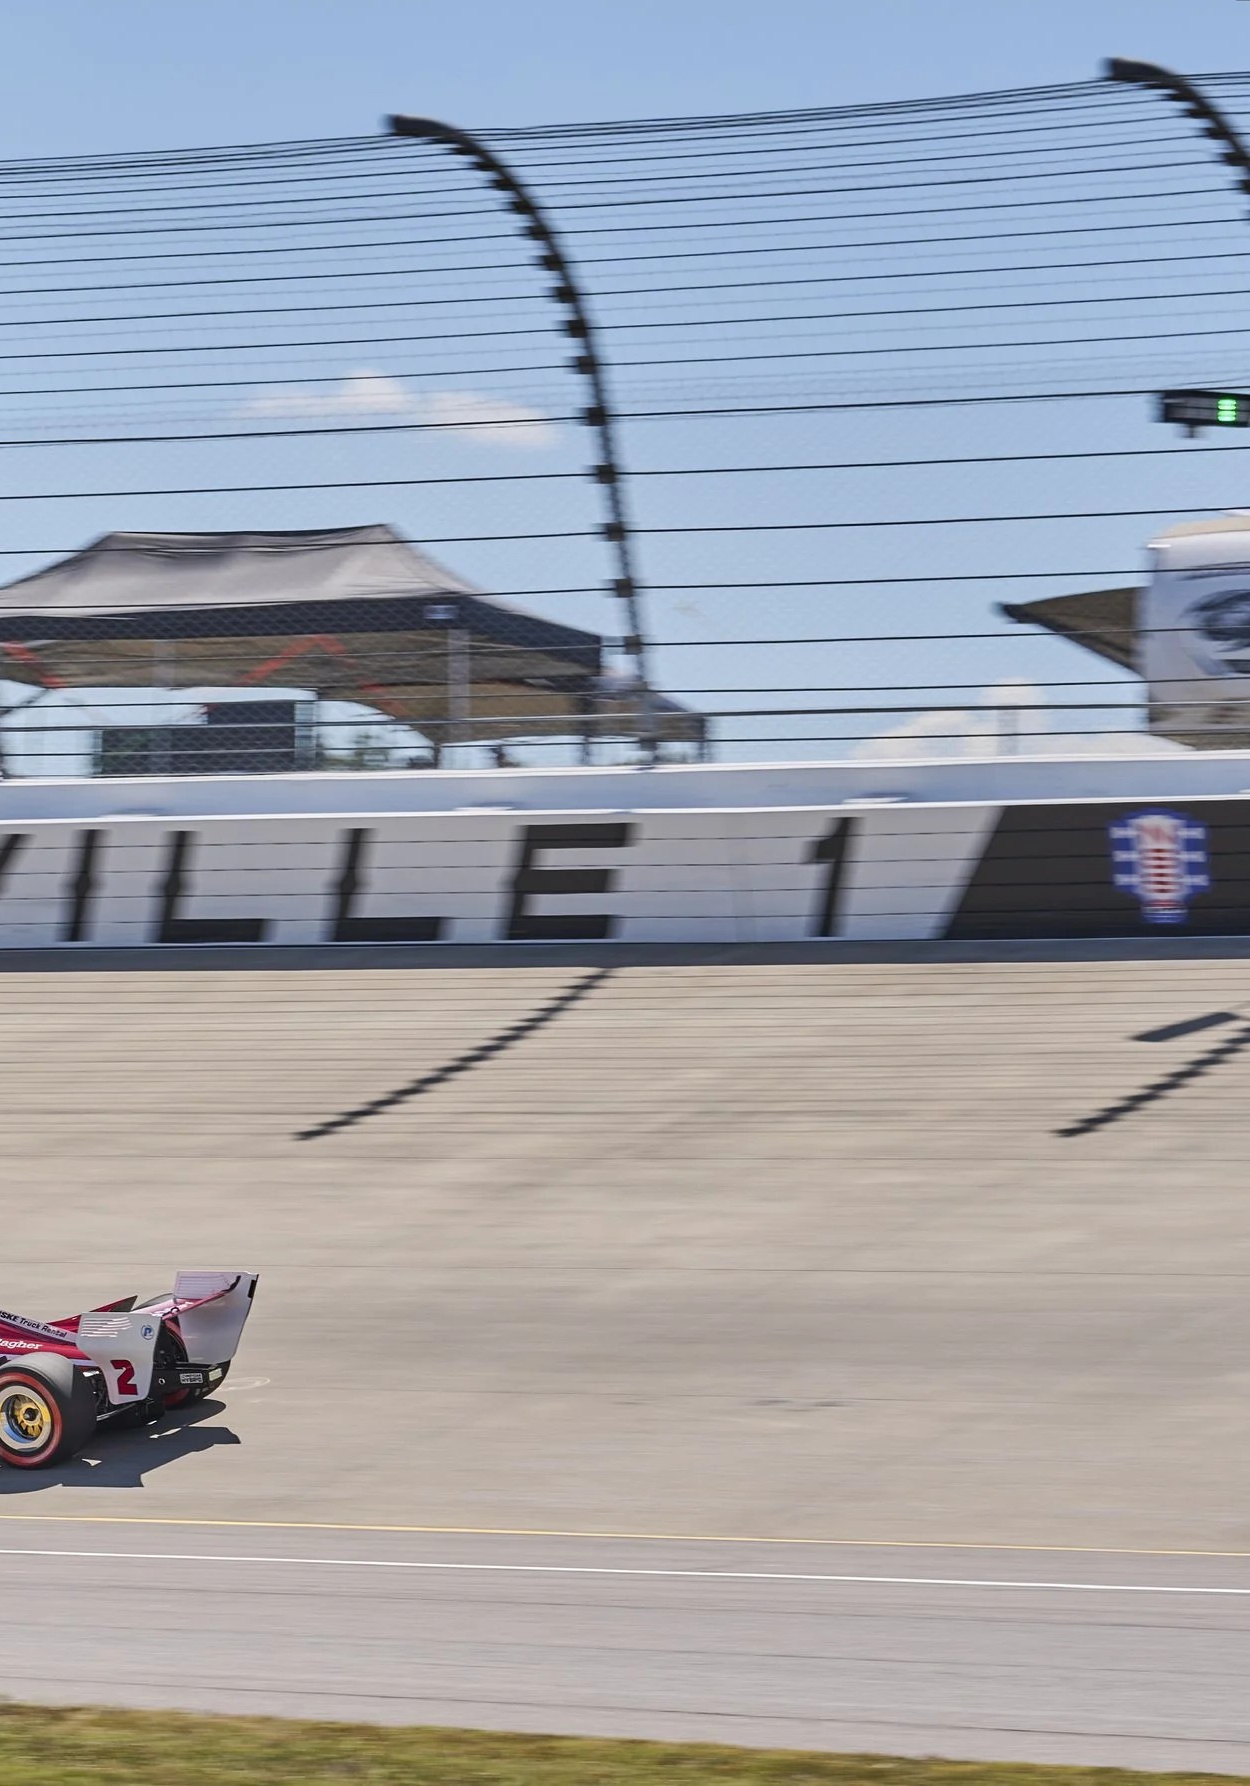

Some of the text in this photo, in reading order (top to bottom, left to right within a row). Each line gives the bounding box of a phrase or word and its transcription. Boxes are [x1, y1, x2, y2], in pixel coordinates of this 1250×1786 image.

[802, 817, 860, 938] 1
[20, 1317, 41, 1330] Truck
[41, 1324, 68, 1338] Rental
[110, 1359, 139, 1396] 2
